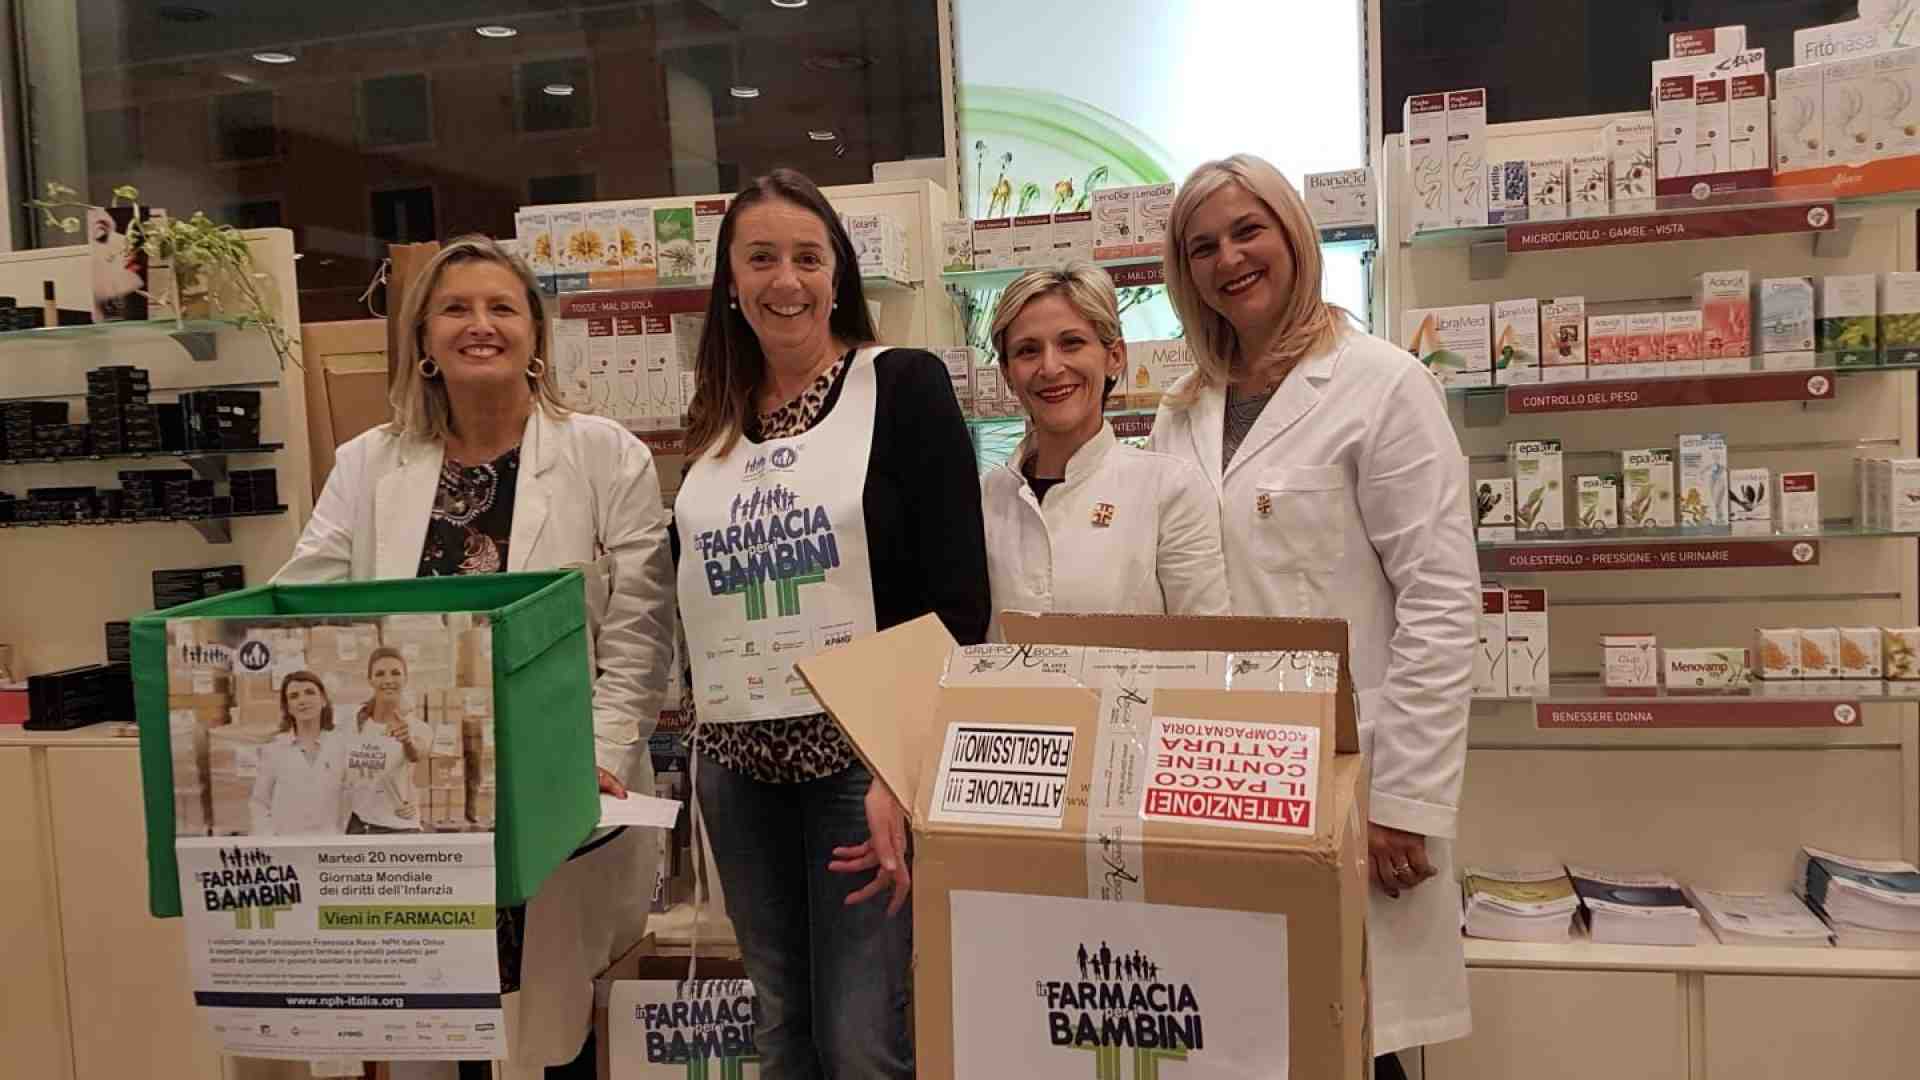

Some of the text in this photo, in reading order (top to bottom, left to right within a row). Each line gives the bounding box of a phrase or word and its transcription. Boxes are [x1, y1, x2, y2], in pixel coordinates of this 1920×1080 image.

[1521, 231, 1600, 245] MICROCIRCOLO
[1608, 225, 1646, 239] GAMBE
[1656, 223, 1685, 235] VISTA
[1522, 391, 1639, 409] CONTROLLO DEL PESO
[702, 505, 832, 560] FARMACIA
[705, 533, 841, 596] BAMBINI
[1509, 555, 1584, 566] COLESTEROLO
[1592, 553, 1651, 563] PRESSIONE
[1659, 552, 1678, 562] VIE
[1678, 550, 1729, 562] URINARIE
[1671, 661, 1728, 673] Menovamp
[1551, 711, 1654, 722] BENESSERE DONNA
[1161, 736, 1308, 760] FATTURA
[1156, 754, 1306, 777] CONTIENE
[966, 779, 1064, 809] ATTENZIONE
[1154, 772, 1306, 797] IL PACCO
[1150, 790, 1306, 824] ATTENZIONE!
[368, 851, 386, 864] 20
[390, 850, 463, 863] novembre
[202, 864, 298, 889] FARMACIA
[319, 871, 433, 883] Giornata Mondiale
[204, 883, 302, 912] BAMBINI
[319, 883, 453, 896] dei diritti dell'Infanzia
[325, 911, 476, 925] Vieni in FARMACIA!
[286, 995, 405, 1008] www.nph-italia.org
[1047, 981, 1199, 1012] FARMACIA
[1048, 1011, 1204, 1050] BAMBINI
